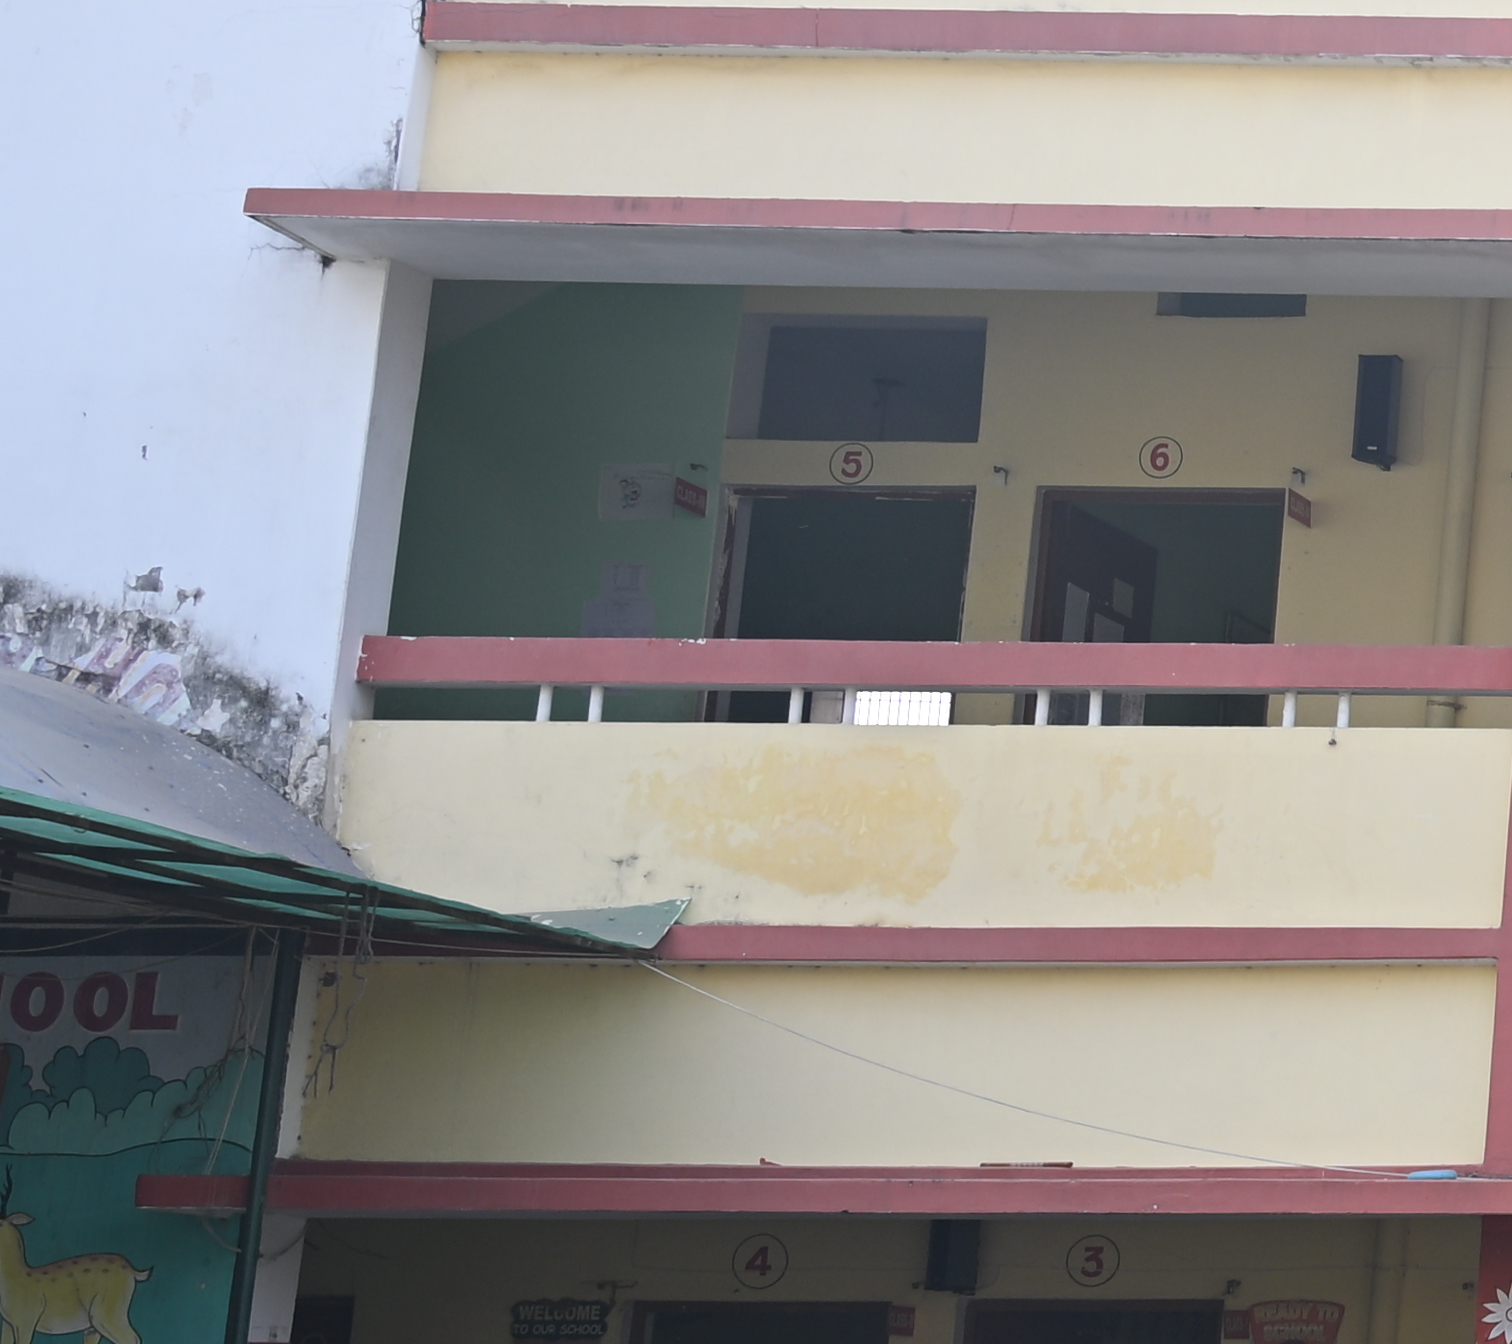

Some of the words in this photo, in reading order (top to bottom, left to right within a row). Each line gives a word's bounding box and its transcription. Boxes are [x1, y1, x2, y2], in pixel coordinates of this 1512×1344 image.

[841, 451, 863, 478] 5
[1150, 443, 1170, 471] 6
[0, 971, 179, 1032] OOL
[745, 1246, 771, 1276] 4
[1081, 1246, 1105, 1277] 3
[519, 1305, 601, 1320] WELCOME
[1254, 1302, 1314, 1323] READY
[1317, 1304, 1339, 1323] TO
[513, 1324, 529, 1335] TO
[559, 1324, 604, 1336] SCHOOL
[1263, 1323, 1326, 1342] SCHOOL
